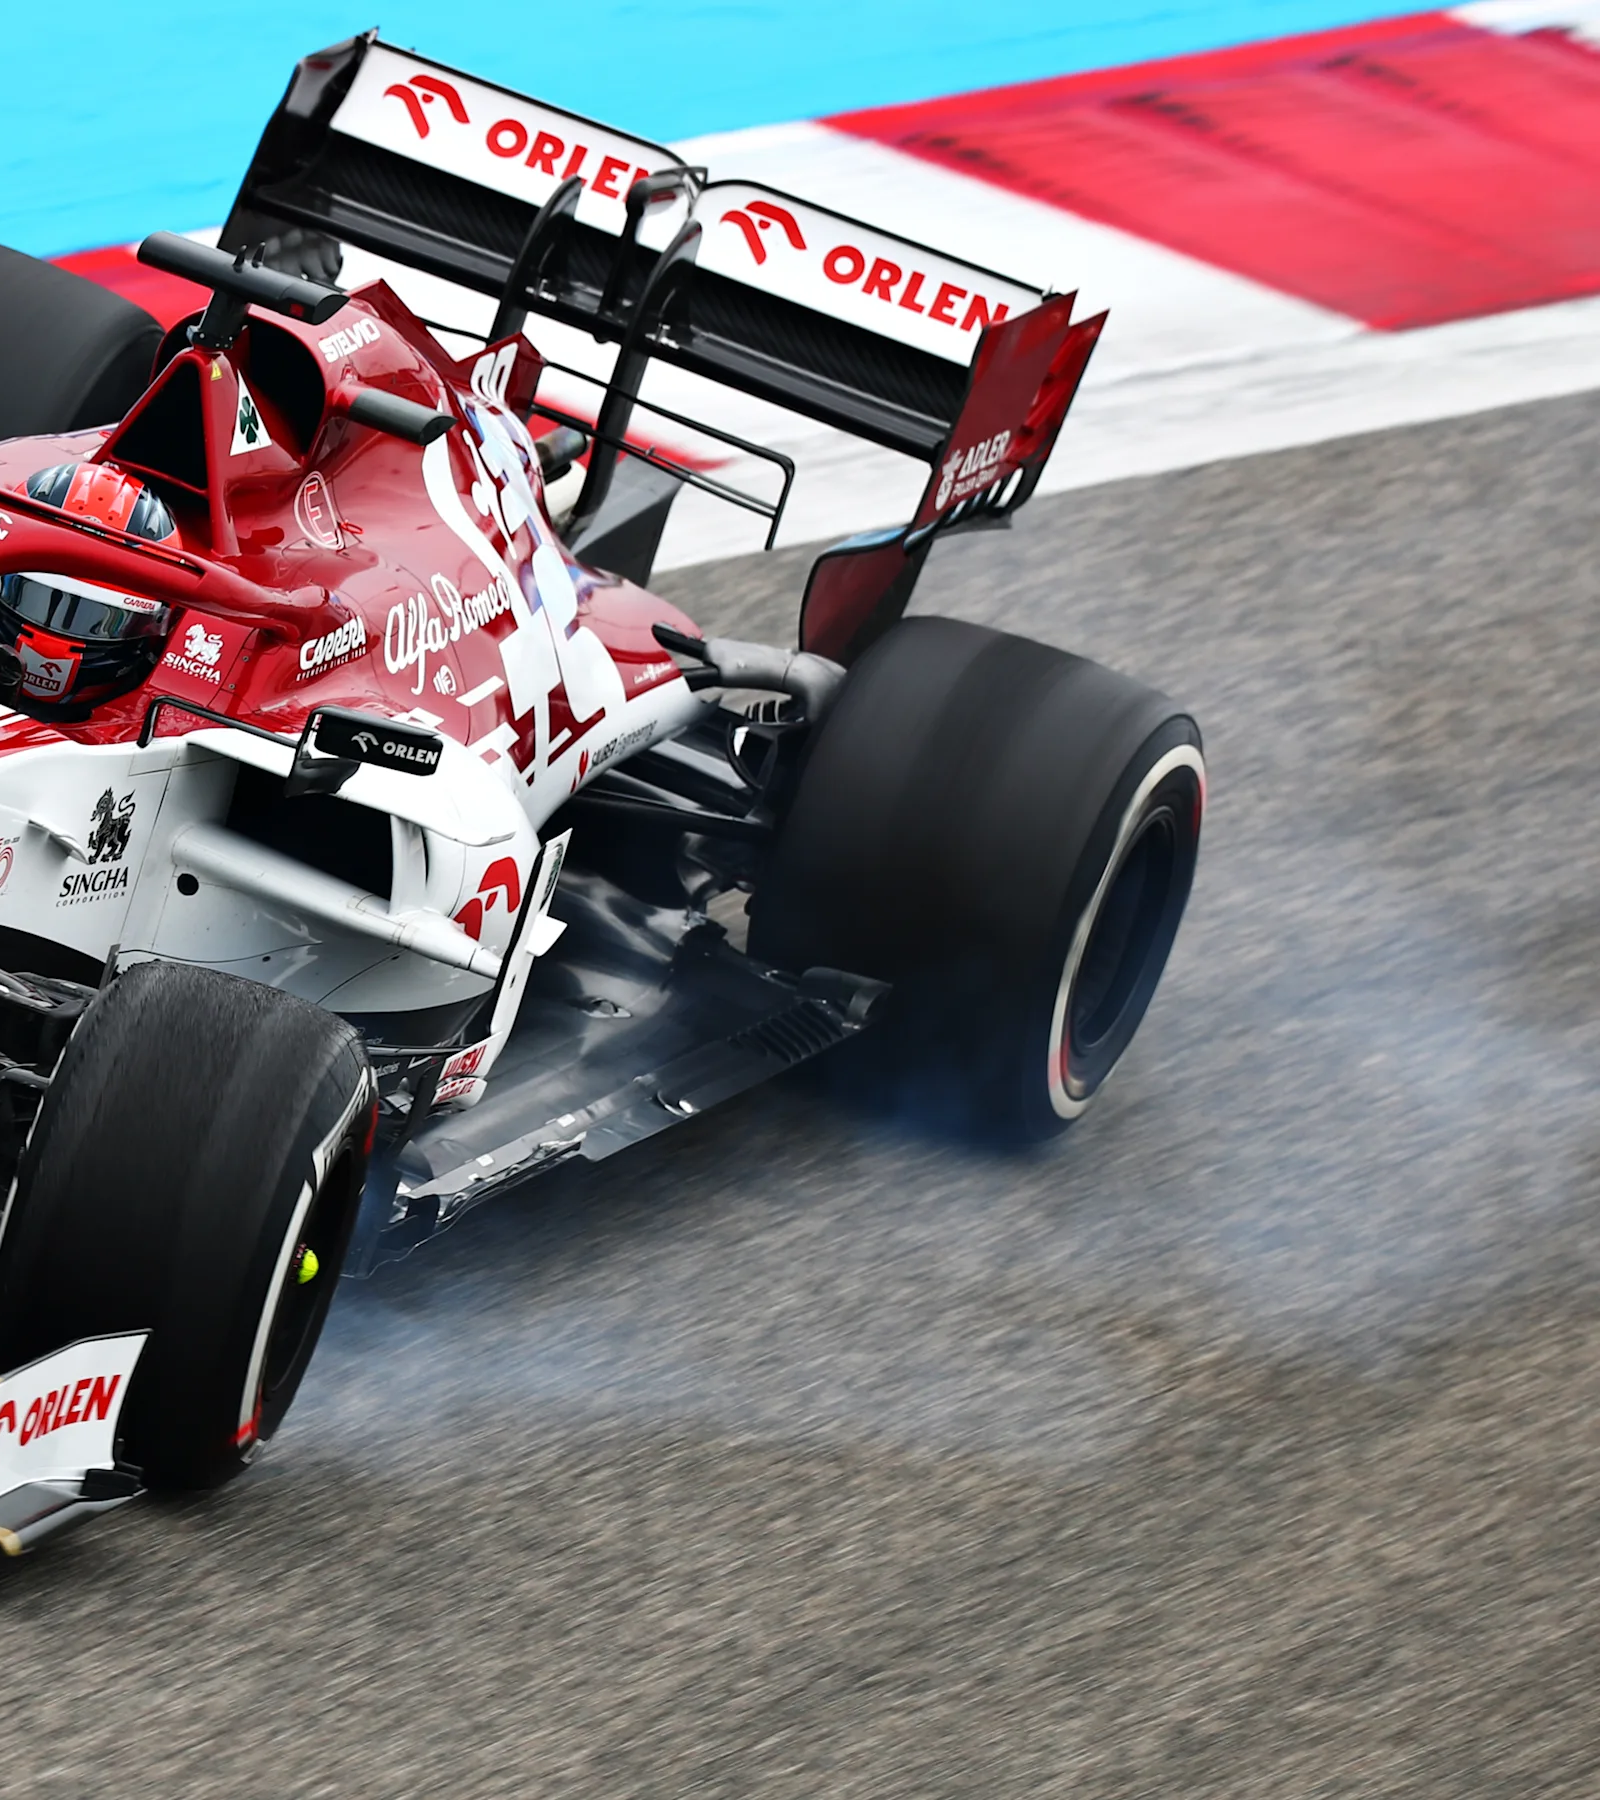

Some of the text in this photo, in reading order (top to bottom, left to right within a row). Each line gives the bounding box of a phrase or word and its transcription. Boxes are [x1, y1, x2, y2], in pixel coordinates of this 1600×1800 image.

[823, 245, 1010, 332] ORLEN
[318, 317, 381, 363] STELVIO
[958, 429, 1011, 479] ADLER
[299, 615, 367, 671] CARRERA
[384, 572, 511, 696] Alfa Romeo
[163, 651, 221, 682] SINGHA
[382, 741, 439, 765] ORLEN
[59, 866, 129, 898] SINGHA
[19, 1374, 122, 1447] ORLEN
